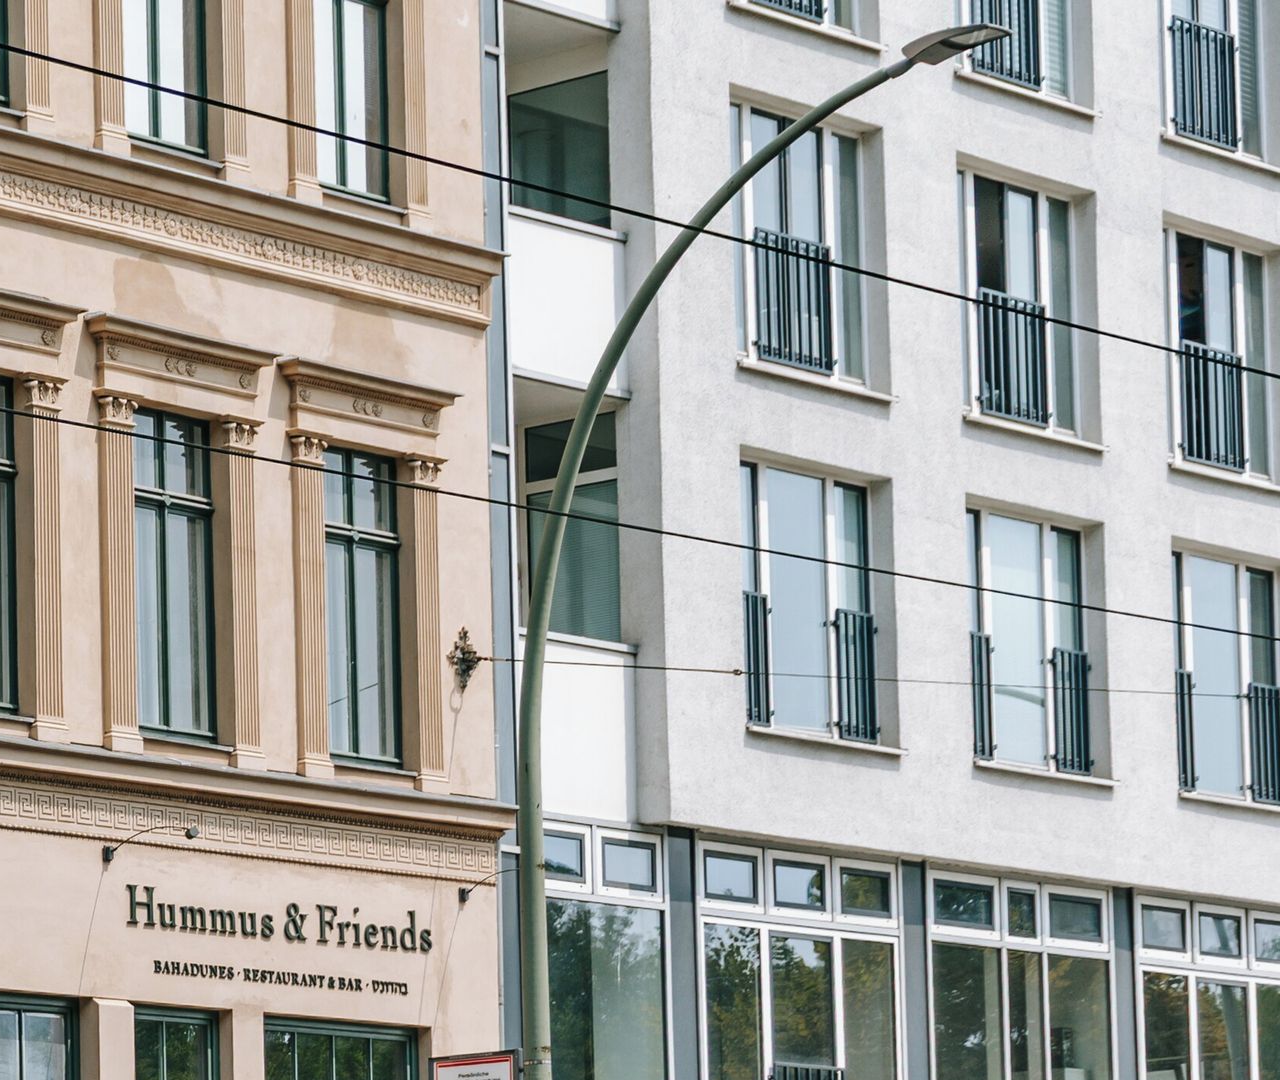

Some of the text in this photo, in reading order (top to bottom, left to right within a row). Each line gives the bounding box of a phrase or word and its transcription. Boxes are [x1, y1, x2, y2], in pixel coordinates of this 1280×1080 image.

[126, 884, 433, 952] Hummus & Friends
[153, 959, 362, 991] BAHADUNES RESTAURANT & BAR
